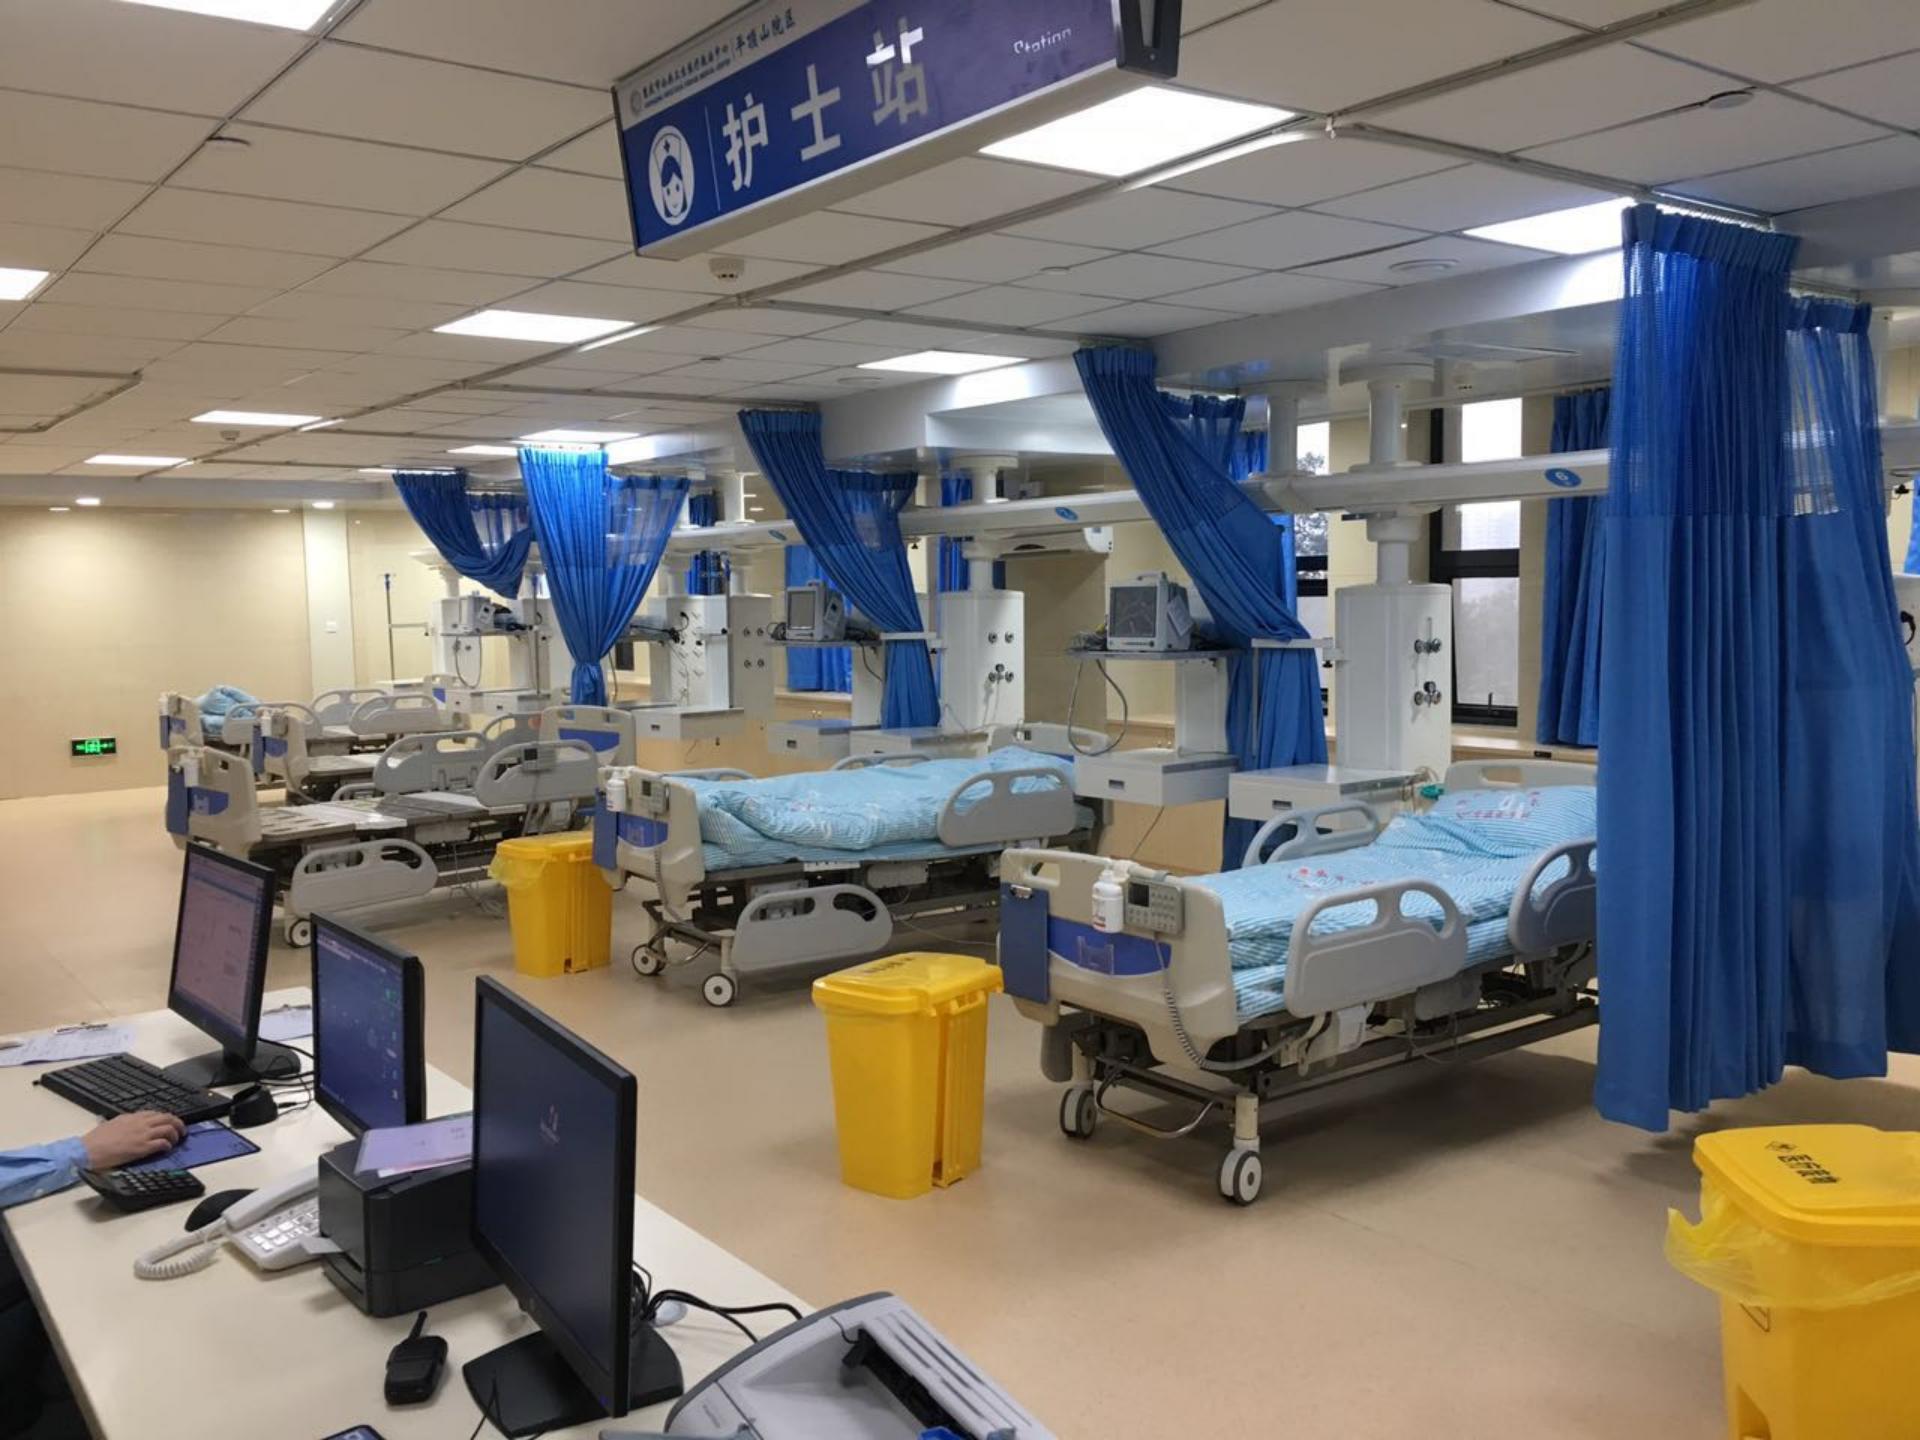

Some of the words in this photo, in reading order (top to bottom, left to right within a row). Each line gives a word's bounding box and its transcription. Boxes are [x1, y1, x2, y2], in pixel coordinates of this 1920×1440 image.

[1013, 27, 1072, 54] Station
[722, 16, 929, 192] 护士站
